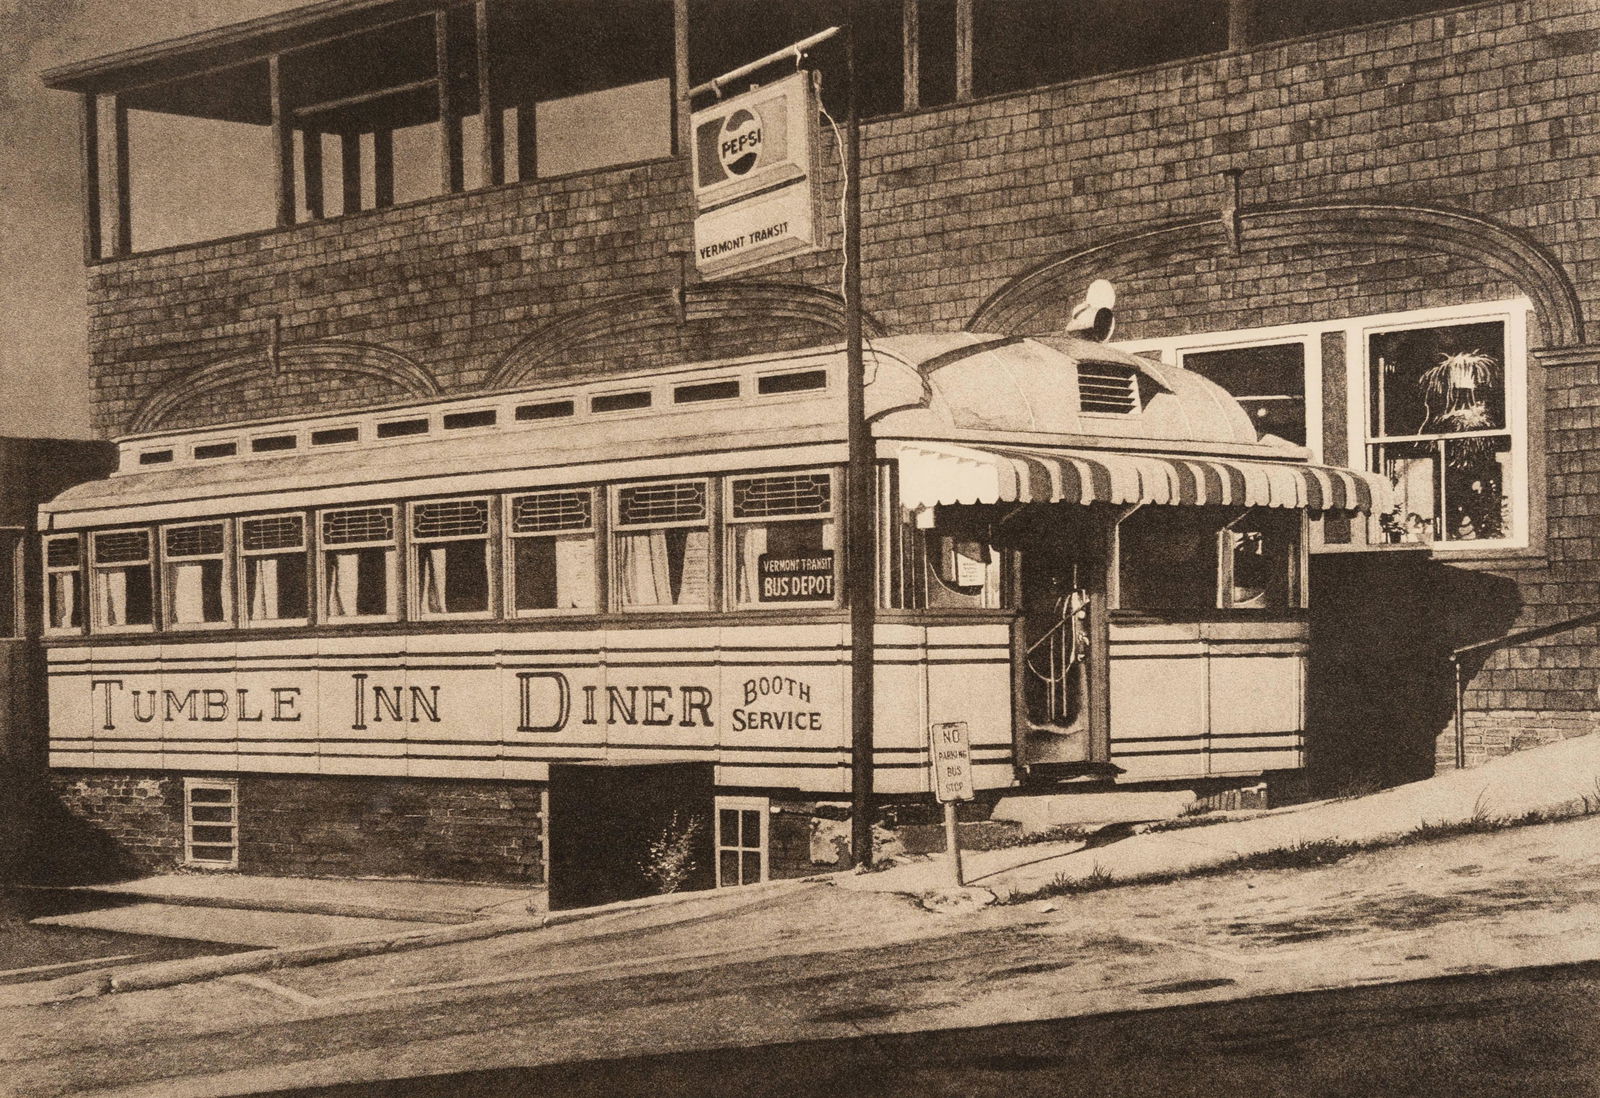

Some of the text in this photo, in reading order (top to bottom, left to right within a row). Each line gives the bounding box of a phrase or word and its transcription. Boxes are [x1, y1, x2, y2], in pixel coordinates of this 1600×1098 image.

[721, 128, 762, 158] PEPSI
[700, 221, 788, 259] VERMONT TRANSIT
[763, 558, 832, 572] VERMONT TRANSIT
[764, 575, 833, 597] BUS DEPOT
[743, 675, 812, 707] BOOTH
[732, 708, 823, 732] SERVICE
[943, 729, 960, 743] NO
[938, 750, 967, 759] PARKING
[947, 766, 962, 777] BUS
[946, 782, 964, 793] STOP
